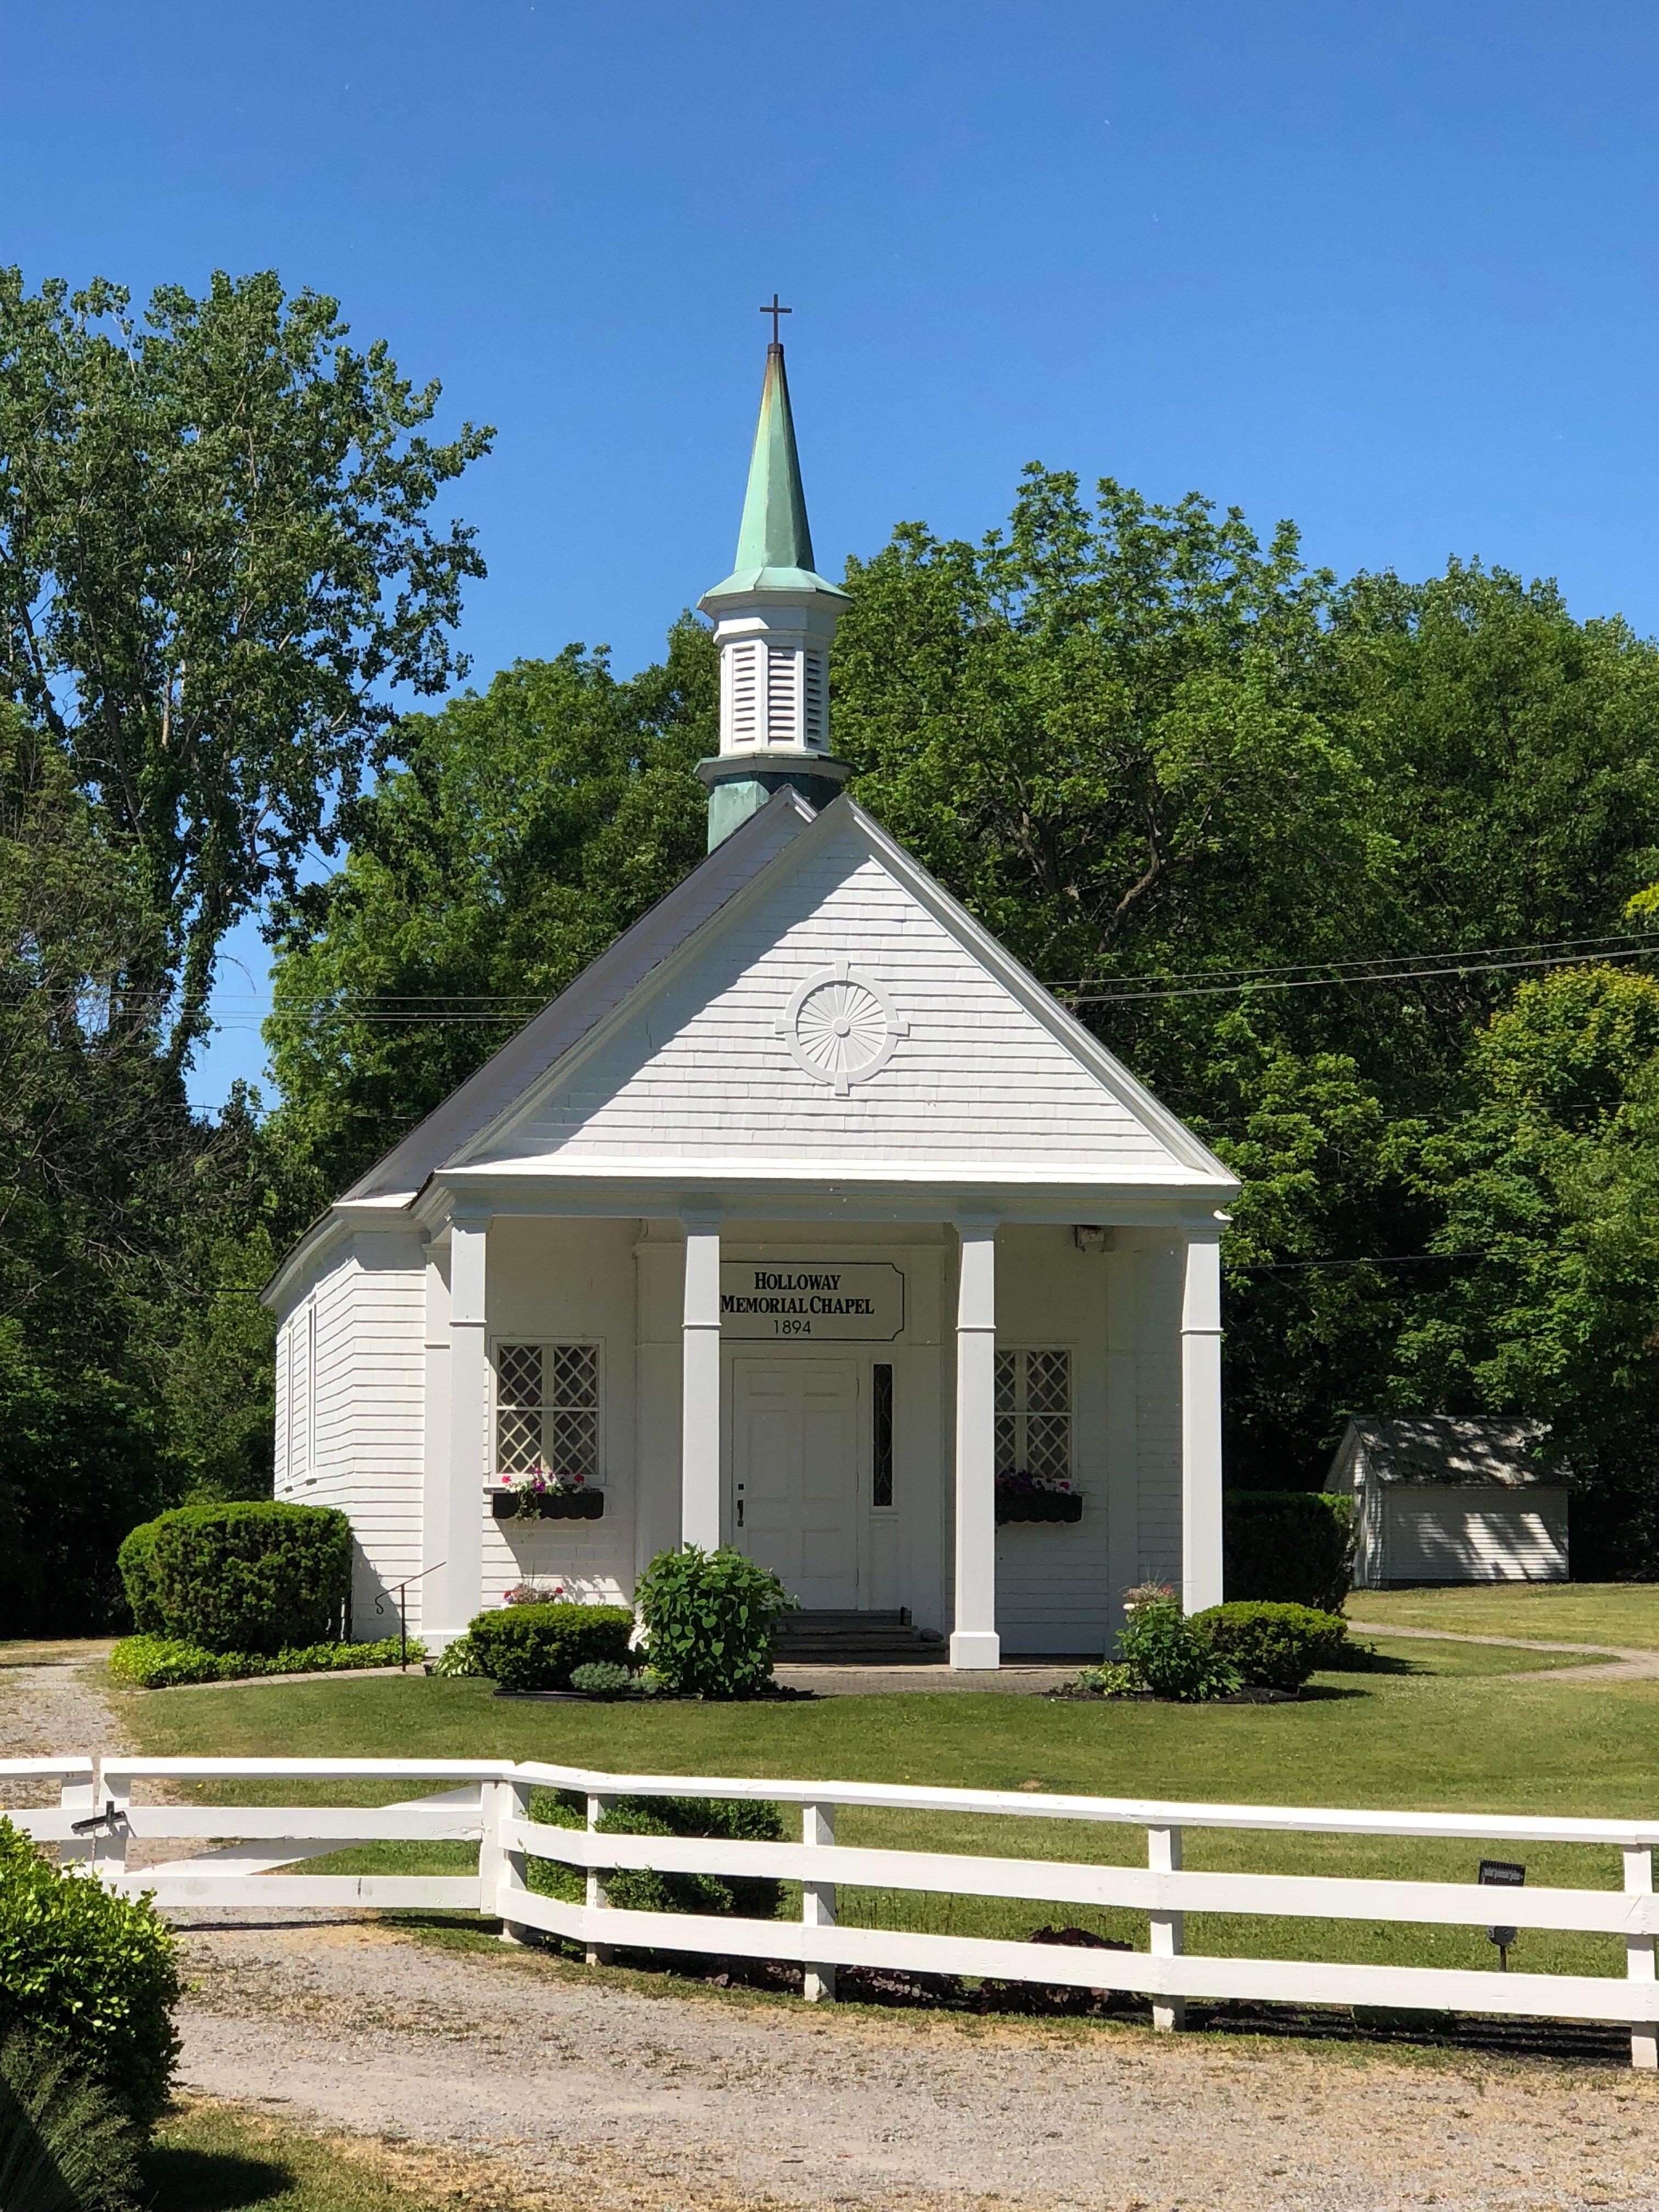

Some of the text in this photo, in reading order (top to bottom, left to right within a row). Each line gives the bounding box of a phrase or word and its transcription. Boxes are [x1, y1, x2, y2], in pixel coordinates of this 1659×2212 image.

[754, 1272, 841, 1290] HOLLOWAY
[720, 1295, 874, 1314] MEMORIAL CHAPEL
[774, 1319, 811, 1334] 1894
